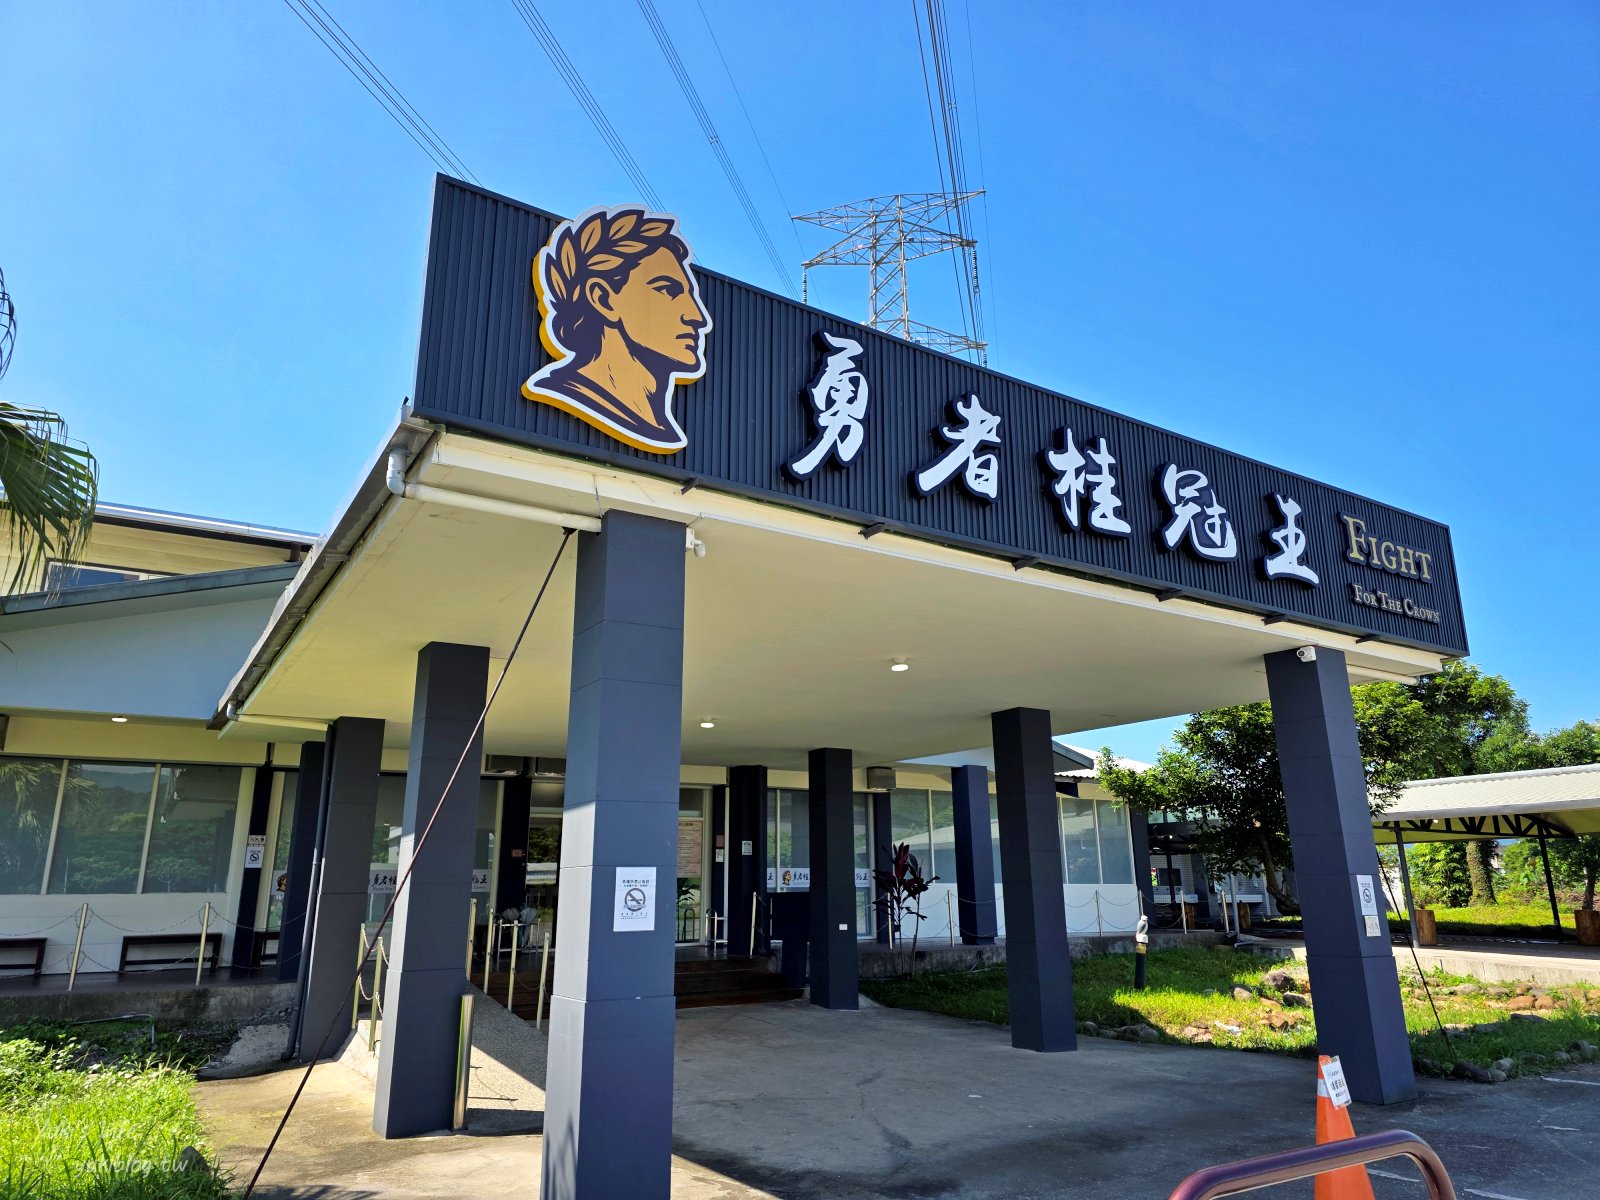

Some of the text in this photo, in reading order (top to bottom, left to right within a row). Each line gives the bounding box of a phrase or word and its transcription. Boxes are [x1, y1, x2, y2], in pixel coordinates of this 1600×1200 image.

[791, 331, 1319, 586] 勇者桂冠王
